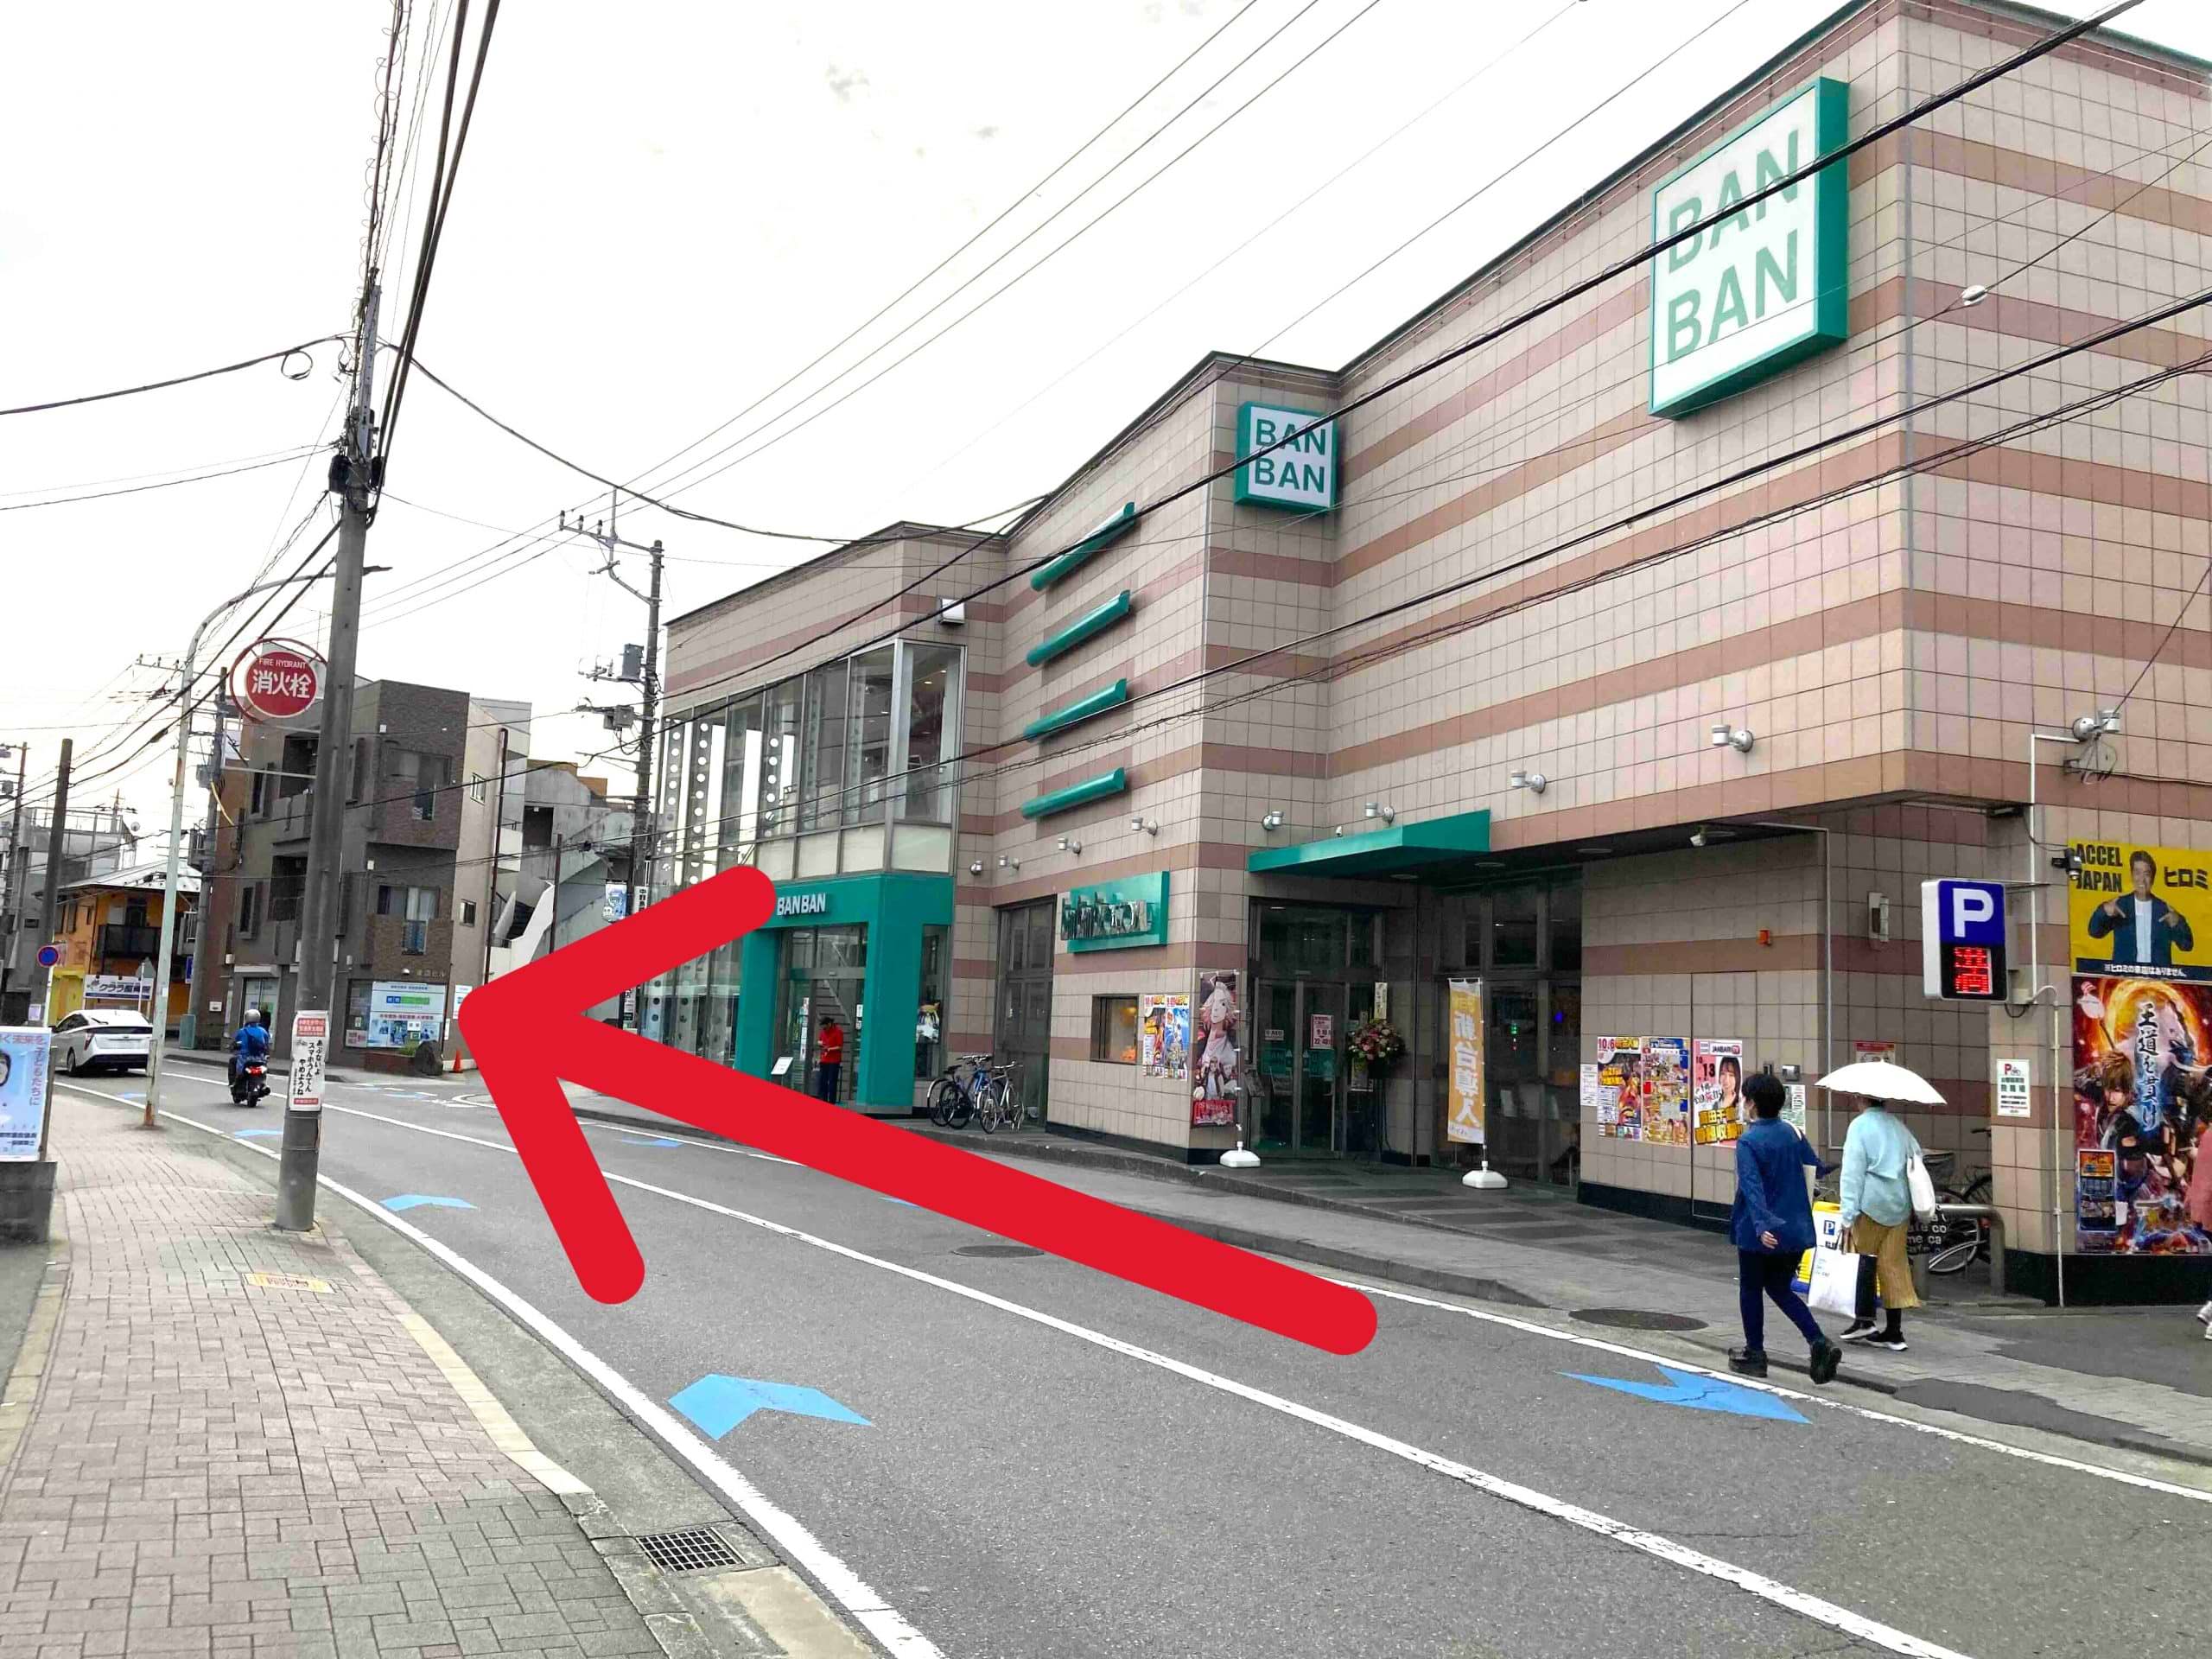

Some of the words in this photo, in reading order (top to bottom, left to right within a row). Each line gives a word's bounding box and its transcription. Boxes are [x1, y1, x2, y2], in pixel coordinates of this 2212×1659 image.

[1669, 129, 1799, 274] BAN
[1668, 229, 1798, 365] BAN
[1255, 418, 1326, 456] BAN
[1255, 457, 1325, 494] BAN
[259, 658, 274, 666] FIRE
[276, 658, 307, 669] HYDRANT
[251, 669, 312, 699] 消火栓
[2076, 843, 2123, 868] ACCEL
[2075, 870, 2123, 893] JAPAN
[2164, 867, 2209, 890] ヒロミ
[777, 893, 826, 916] BANBAN
[1953, 887, 1994, 938] P
[296, 1058, 306, 1096] やめようね
[304, 1042, 315, 1093] スマホうんてん
[1702, 1063, 1715, 1077] 13
[2004, 1063, 2012, 1076] P
[2137, 1002, 2160, 1128] 王道を貫け
[1826, 1222, 1834, 1236] P
